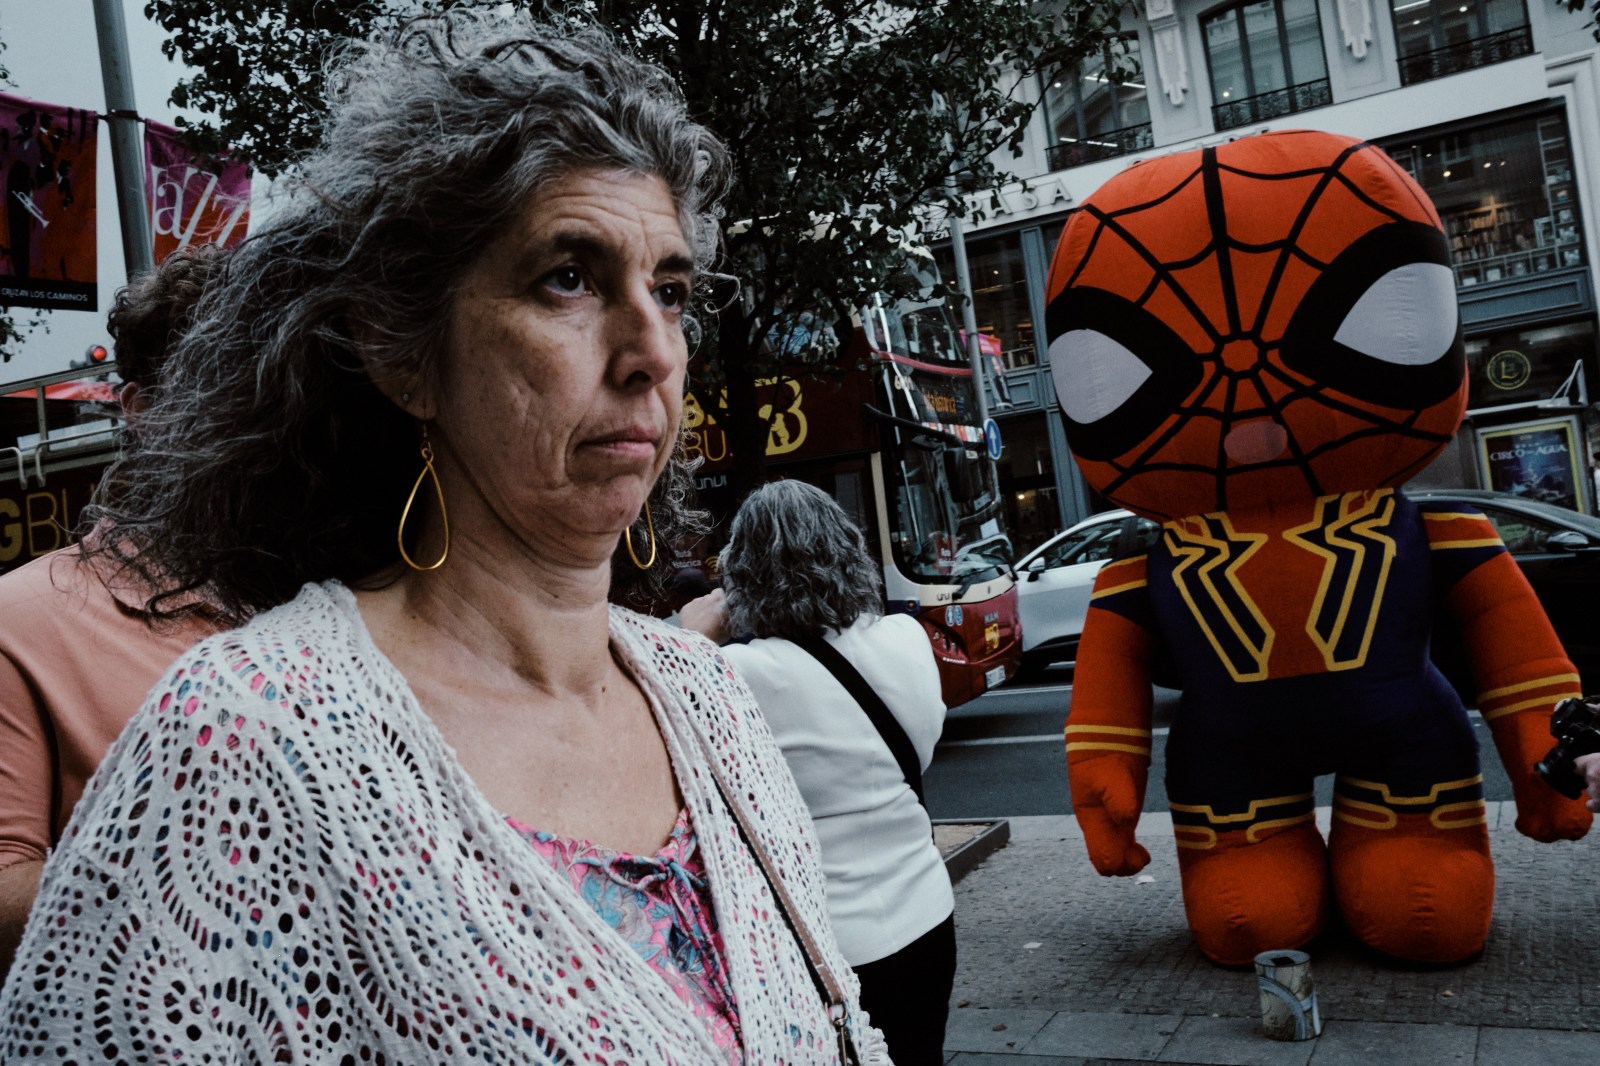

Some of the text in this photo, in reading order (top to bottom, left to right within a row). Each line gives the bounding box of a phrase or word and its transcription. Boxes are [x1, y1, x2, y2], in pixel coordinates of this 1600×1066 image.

[30, 290, 45, 299] LOS
[46, 291, 88, 302] CAMINOS
[1490, 448, 1525, 461] CIRCO
